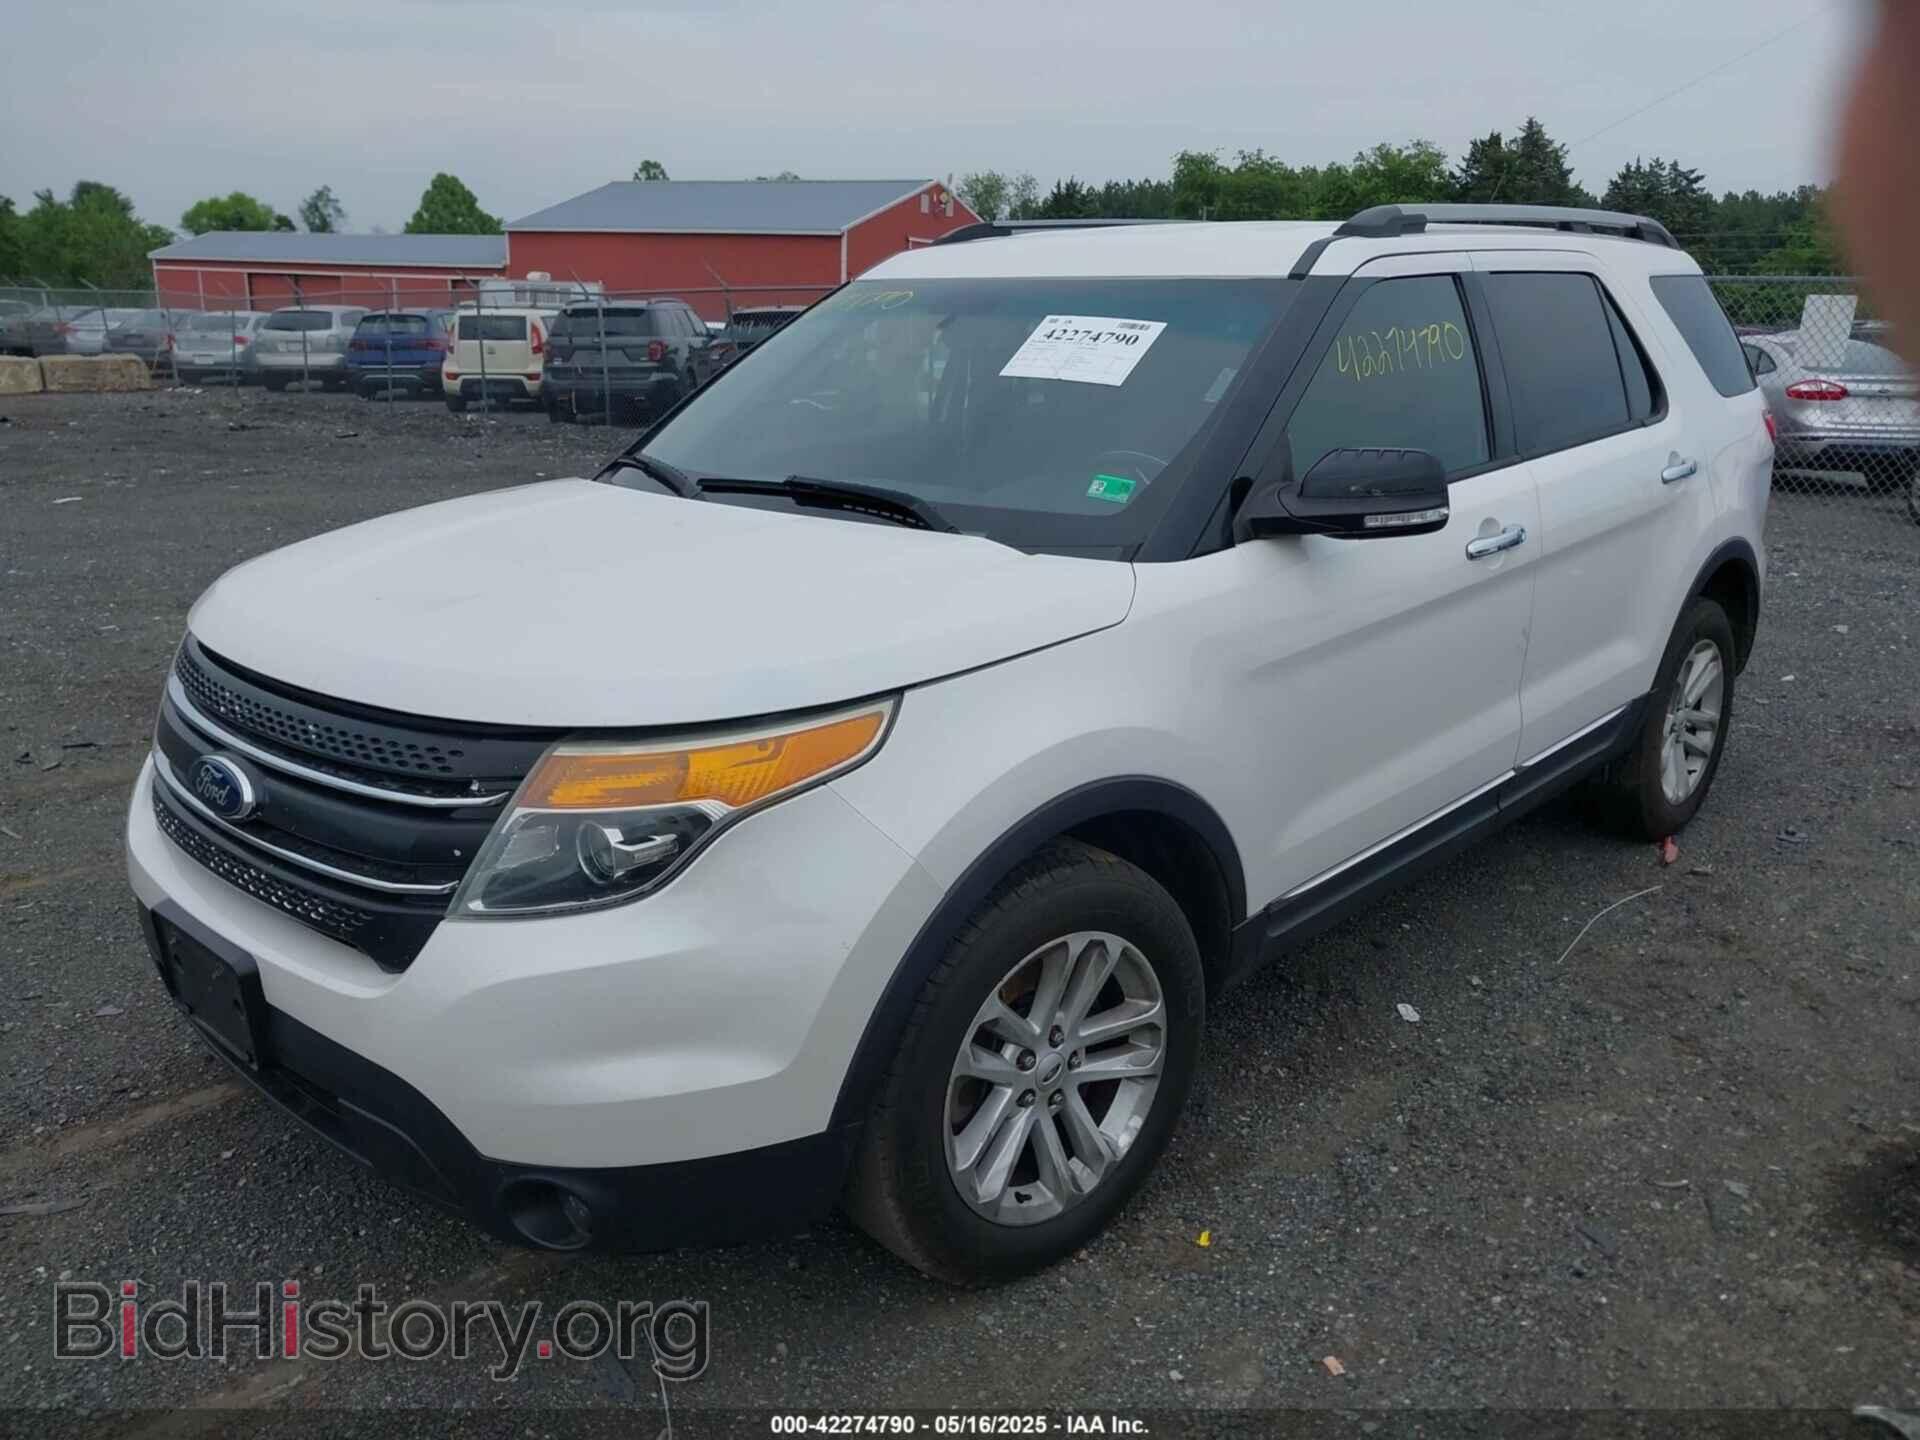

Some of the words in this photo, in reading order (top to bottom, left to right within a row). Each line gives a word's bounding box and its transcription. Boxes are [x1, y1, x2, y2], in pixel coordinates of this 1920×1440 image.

[1043, 328, 1140, 346] 42274790
[1336, 320, 1465, 382] 42274790
[196, 764, 231, 806] Ford
